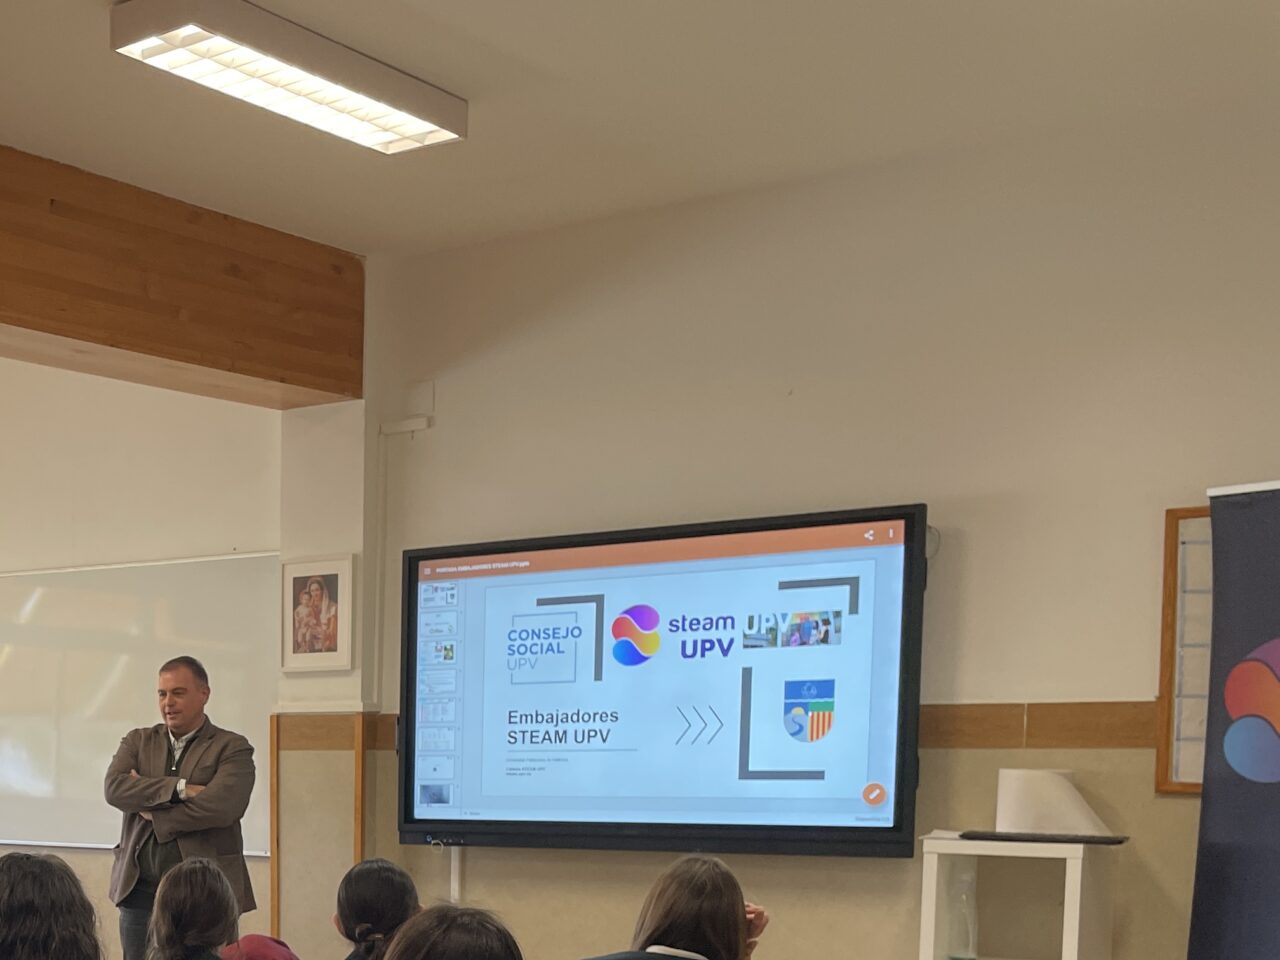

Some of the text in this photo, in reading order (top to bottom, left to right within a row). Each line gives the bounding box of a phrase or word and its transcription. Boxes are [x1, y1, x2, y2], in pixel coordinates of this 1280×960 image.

[668, 614, 736, 633] steam
[507, 626, 583, 642] CONSEJO
[507, 642, 565, 656] SOCIAL
[680, 638, 735, 659] UPV
[506, 658, 538, 671] UPV
[507, 709, 619, 728] Embajadores
[507, 728, 611, 745] STEAM UPV
